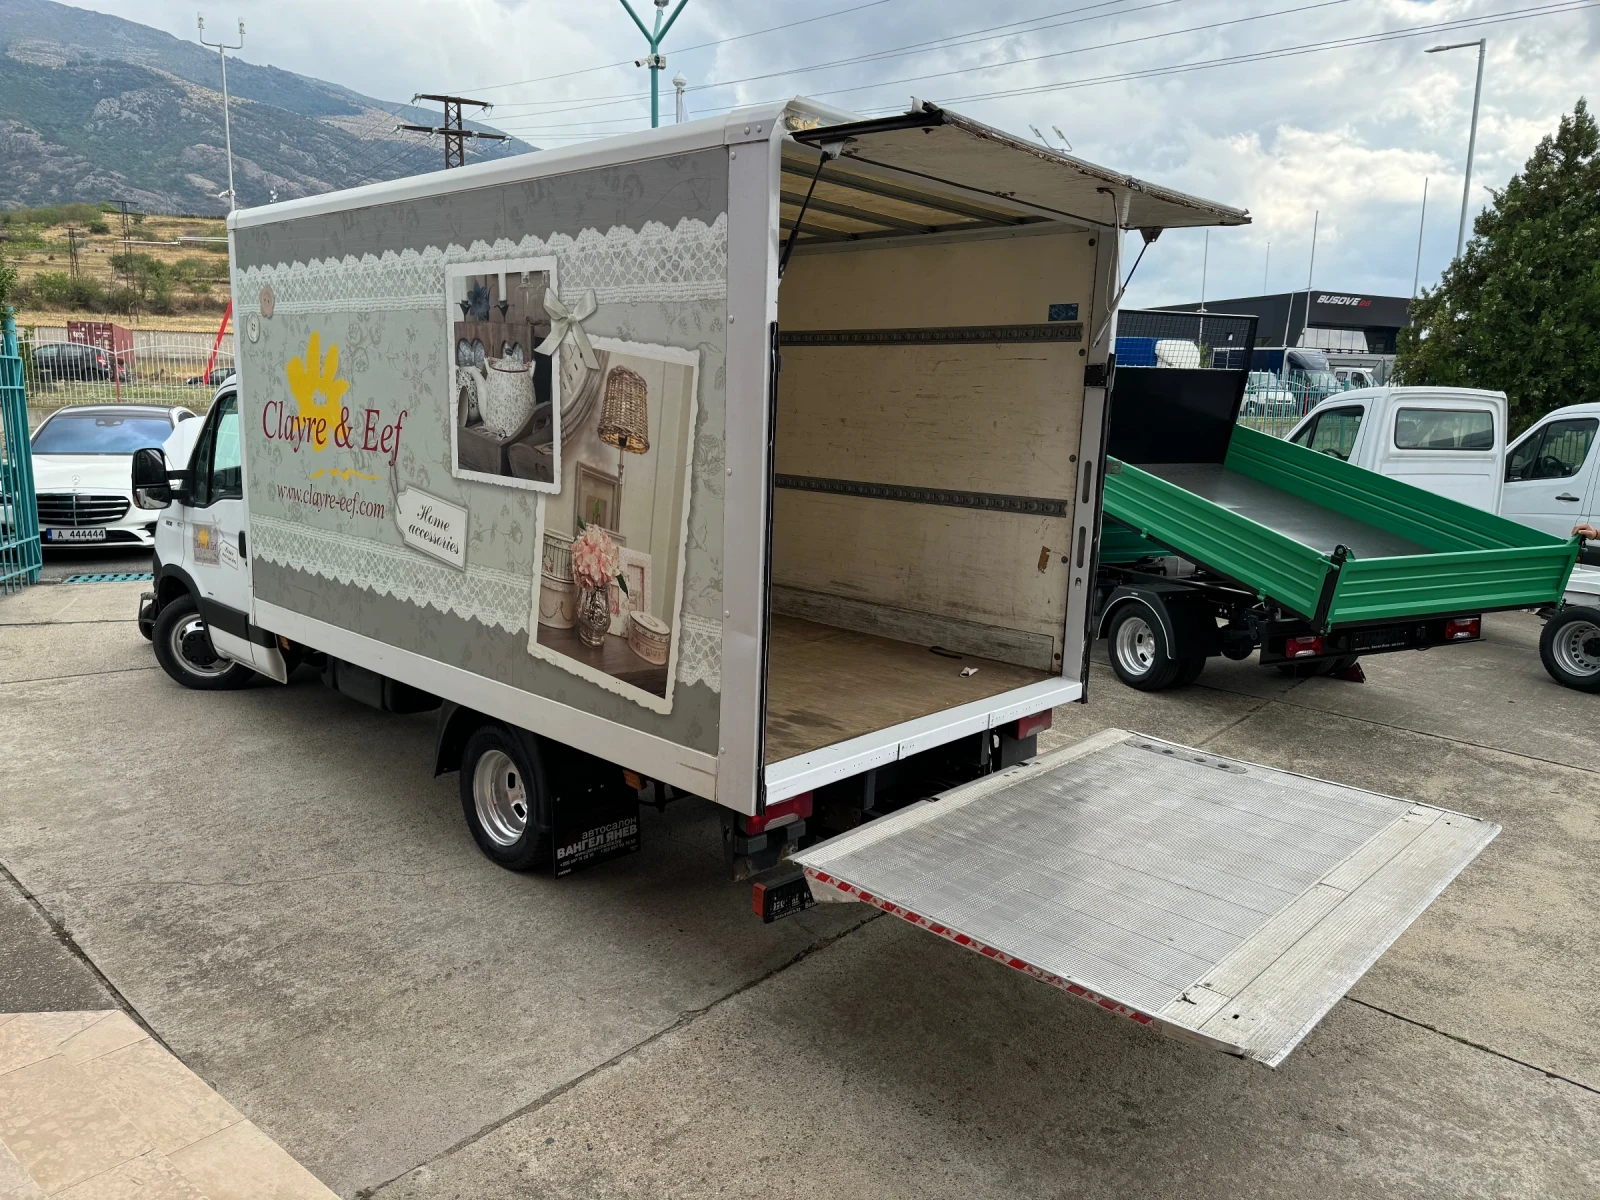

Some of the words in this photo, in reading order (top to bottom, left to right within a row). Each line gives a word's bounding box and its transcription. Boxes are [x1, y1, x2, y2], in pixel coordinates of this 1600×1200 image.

[262, 400, 327, 453] Clayre
[334, 406, 354, 449] &
[361, 409, 408, 467] Eef
[277, 483, 385, 520] www.clayre-eef.com
[417, 504, 450, 532] Home
[57, 530, 64, 539] A
[70, 530, 105, 539] 444444
[408, 524, 460, 555] accessories
[557, 834, 604, 860] ВАНГЕЛ
[605, 824, 638, 842] ЯНЕВ
[582, 816, 637, 840] автосалон
